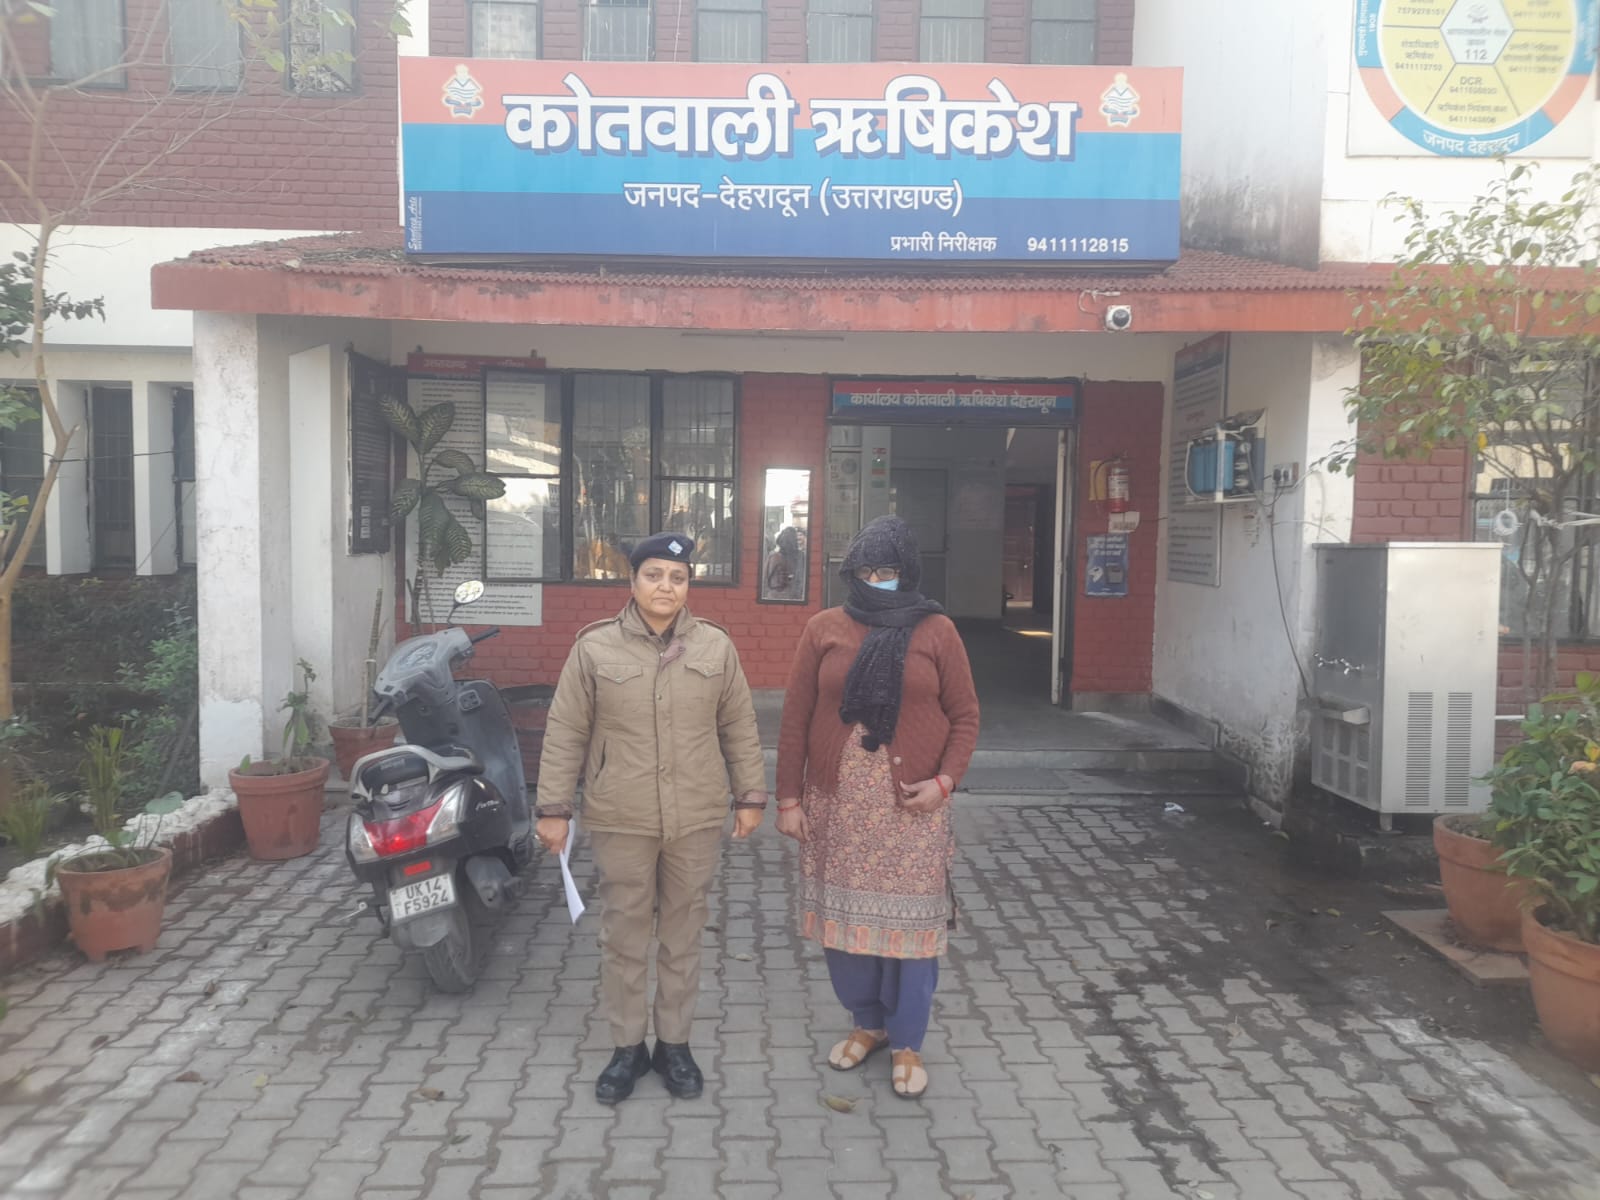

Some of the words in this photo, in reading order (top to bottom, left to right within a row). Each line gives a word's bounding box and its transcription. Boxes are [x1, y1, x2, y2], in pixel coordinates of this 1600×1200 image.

[1465, 49, 1488, 60] 112
[1460, 76, 1482, 85] DCR
[502, 72, 796, 158] कोतवाली
[809, 74, 1079, 158] ऋषिकेश
[1422, 129, 1465, 153] जनपद
[623, 176, 812, 217] जनपद-देहरादून
[819, 177, 964, 217] (उत्तराखण्ड)
[890, 232, 934, 252] प्रभारी
[938, 232, 998, 252] निरीक्षक
[1027, 237, 1130, 254] 9411112815
[850, 388, 901, 407] कार्यालय
[904, 388, 956, 408] कोतवाली
[959, 390, 1008, 408] ऋषिकेश
[1010, 390, 1057, 414] देहरादून
[405, 879, 442, 899] UK14
[404, 889, 449, 915] F5924
